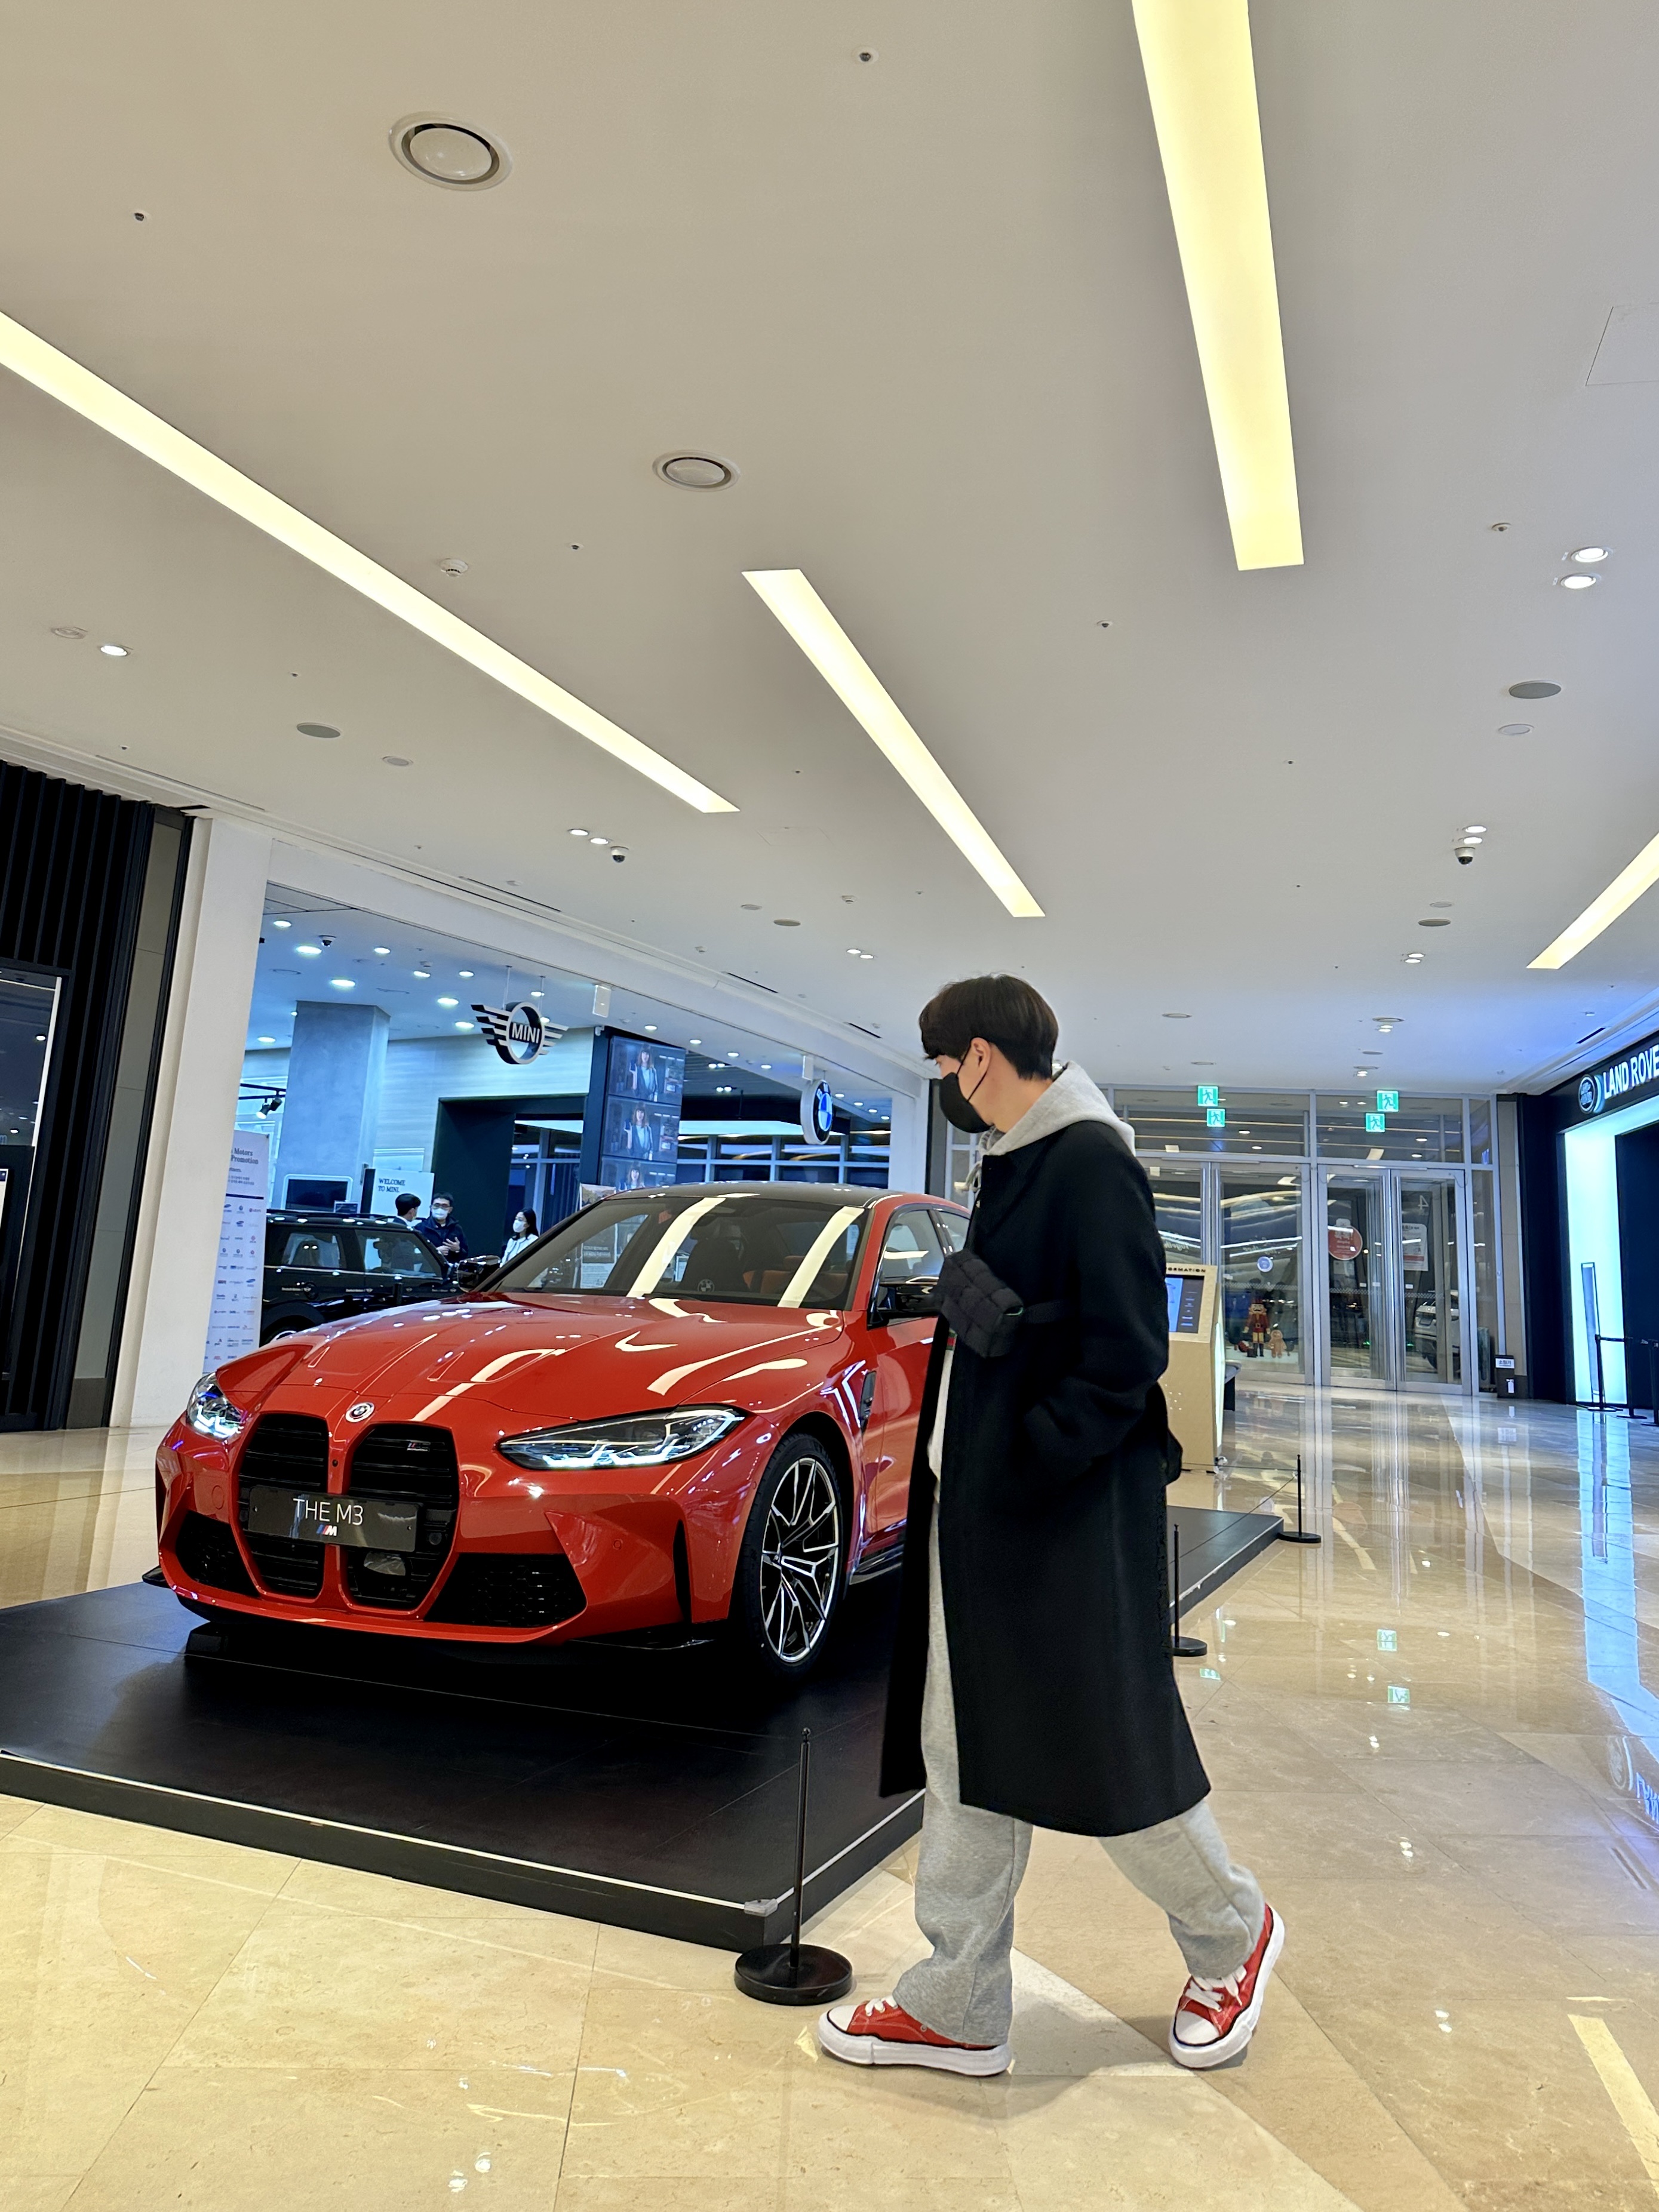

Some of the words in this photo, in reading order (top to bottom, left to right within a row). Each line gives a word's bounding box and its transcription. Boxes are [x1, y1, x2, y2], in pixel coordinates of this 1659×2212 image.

[512, 1022, 540, 1044] MINI
[1603, 1062, 1629, 1100] LAND
[231, 1154, 259, 1164] Promotion
[234, 1147, 253, 1156] Motors
[379, 1178, 405, 1186] WELCOME
[293, 1498, 331, 1522] THE
[336, 1503, 364, 1526] M3
